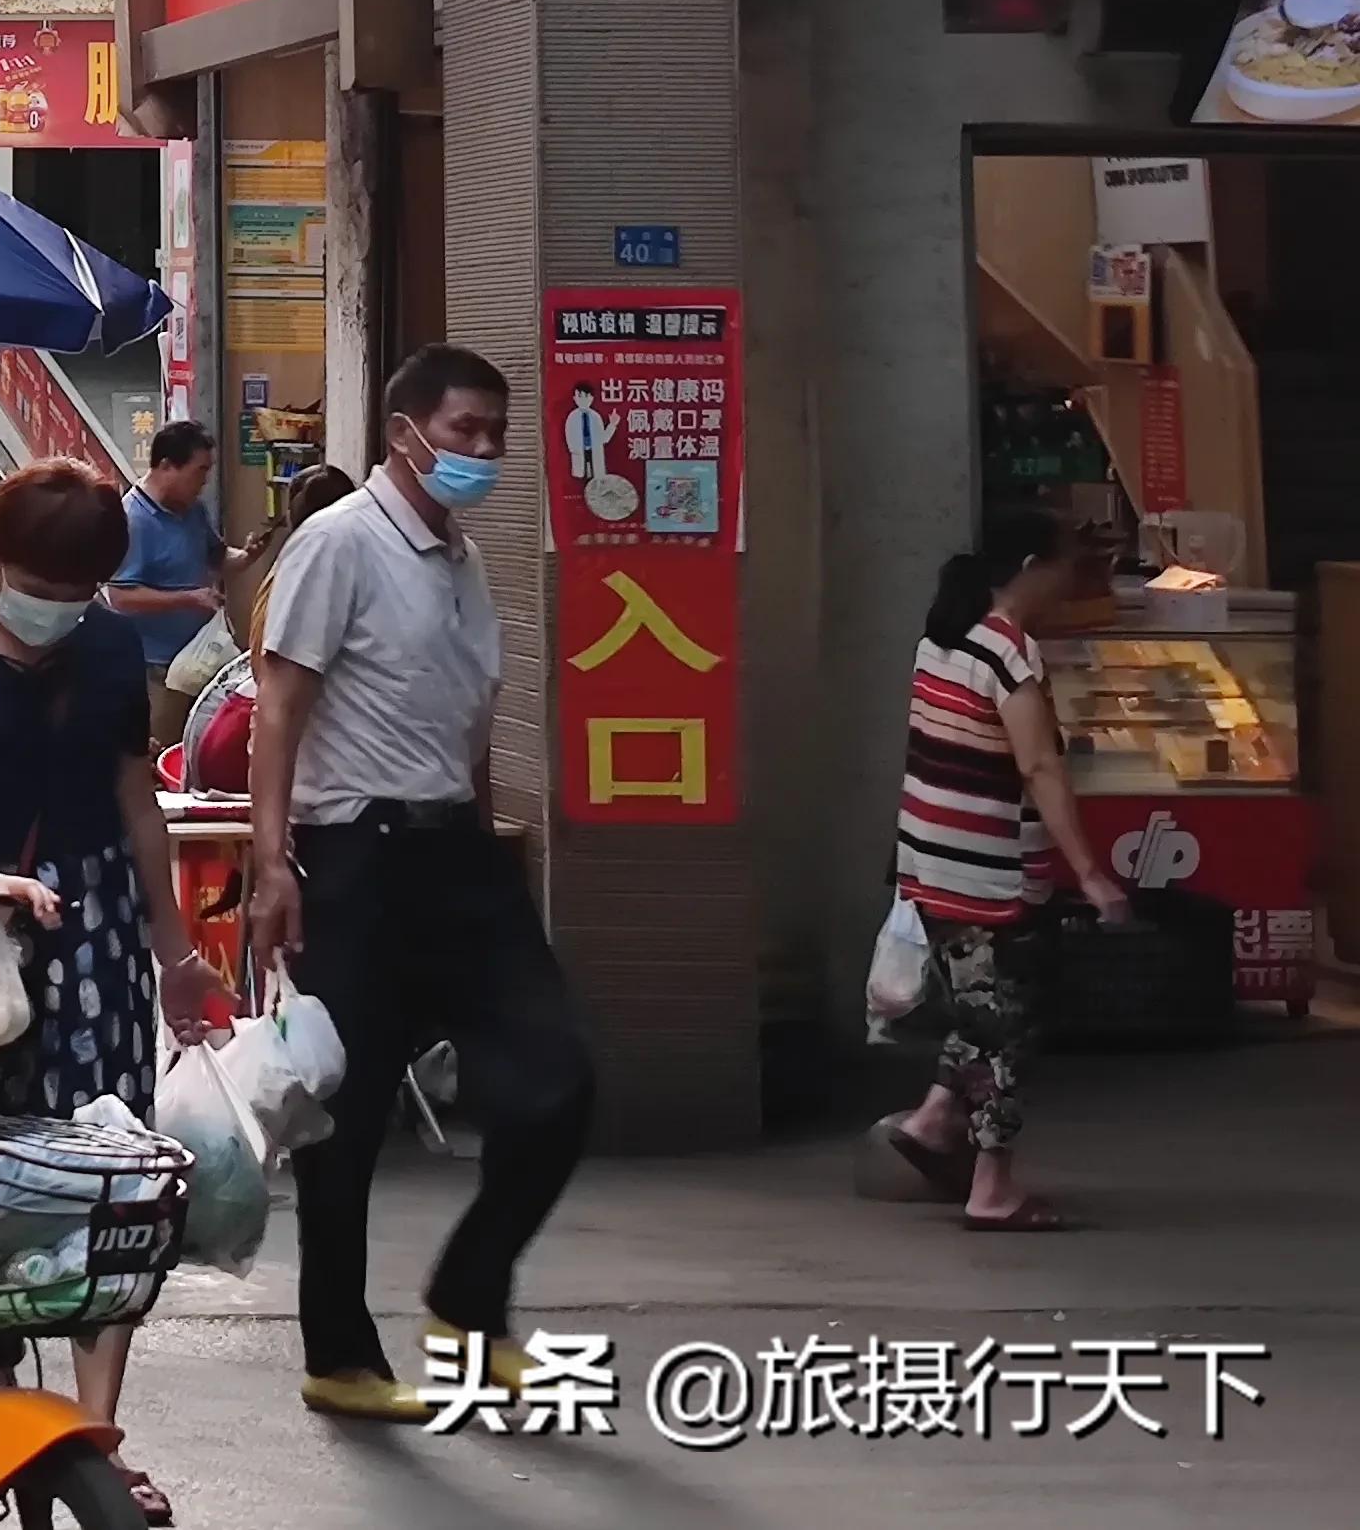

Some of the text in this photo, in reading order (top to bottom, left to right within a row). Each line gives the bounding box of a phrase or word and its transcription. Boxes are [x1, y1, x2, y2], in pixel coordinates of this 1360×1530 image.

[600, 378, 726, 403] 出示健康码
[627, 408, 722, 433] 佩戴口罩
[627, 435, 721, 460] 测量体温
[566, 570, 724, 805] 入口
